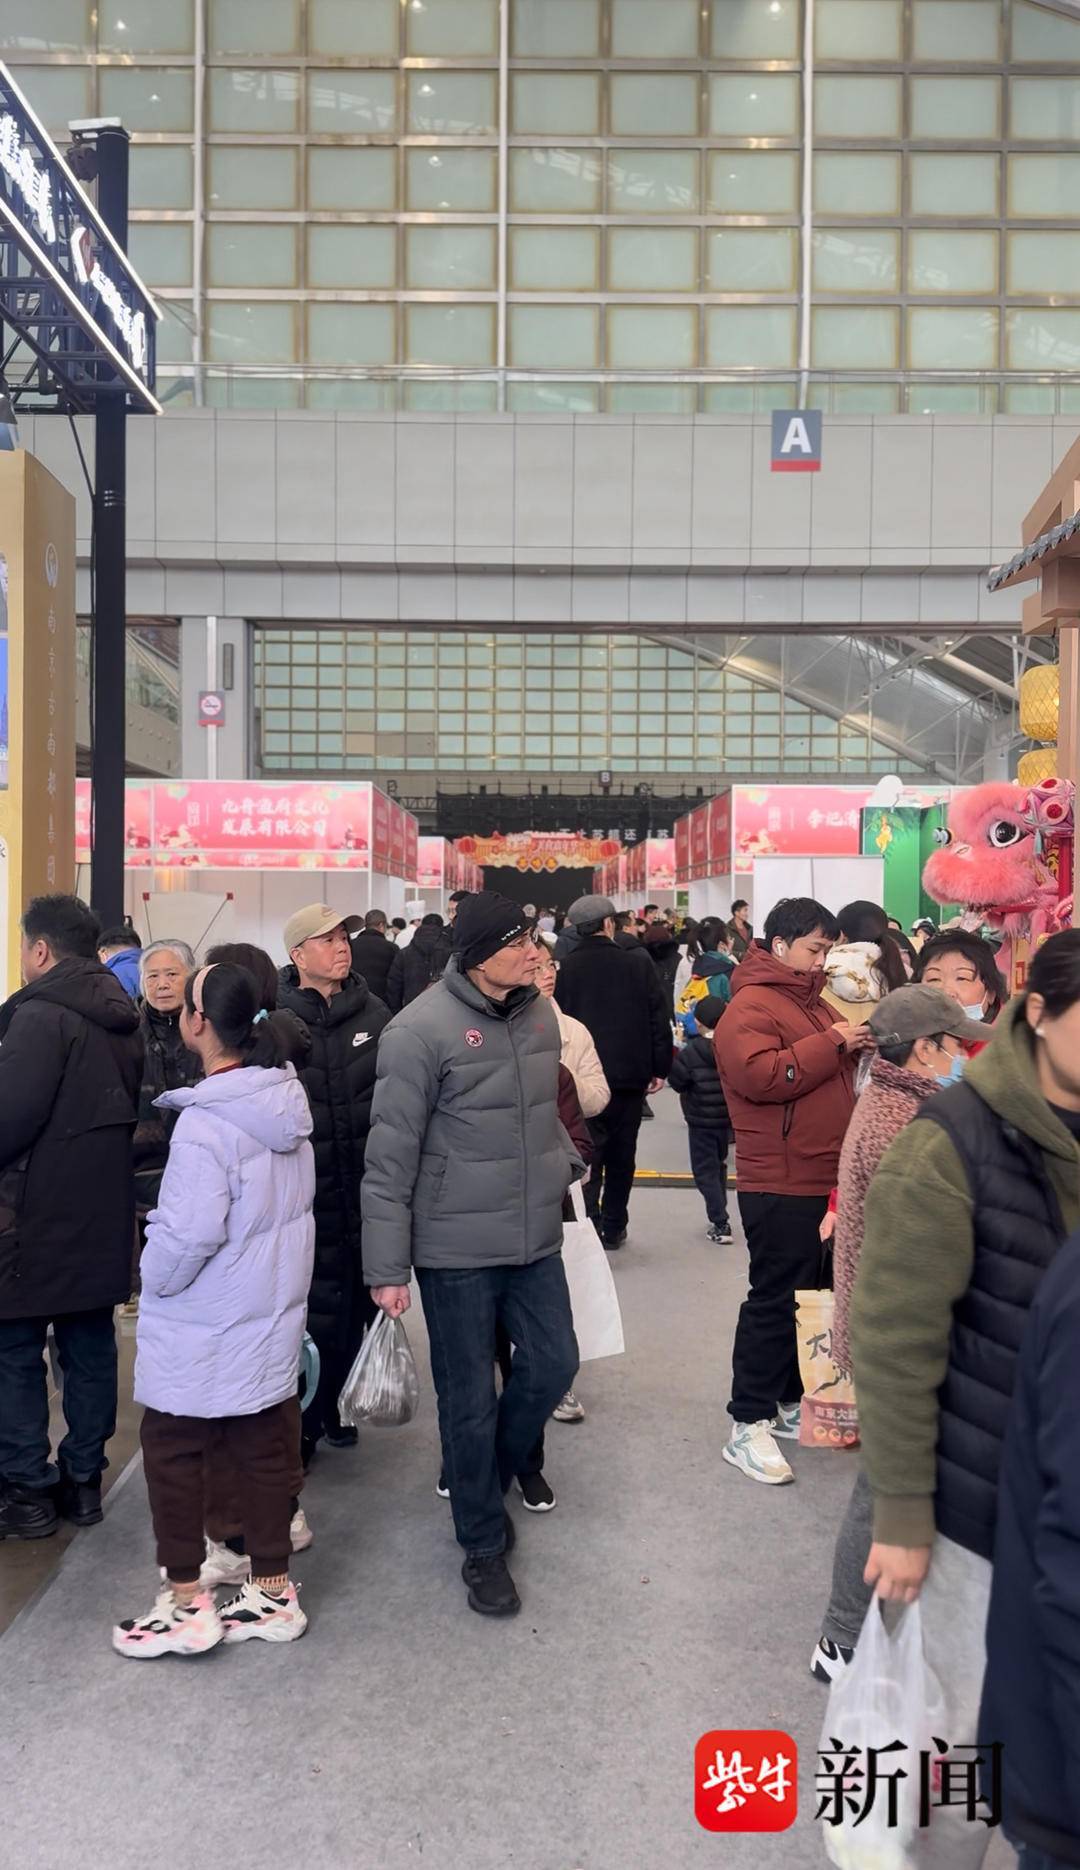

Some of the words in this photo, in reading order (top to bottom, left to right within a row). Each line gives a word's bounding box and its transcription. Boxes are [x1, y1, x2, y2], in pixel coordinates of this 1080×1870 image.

[780, 417, 812, 453] A
[221, 818, 328, 837] 发展有限公司
